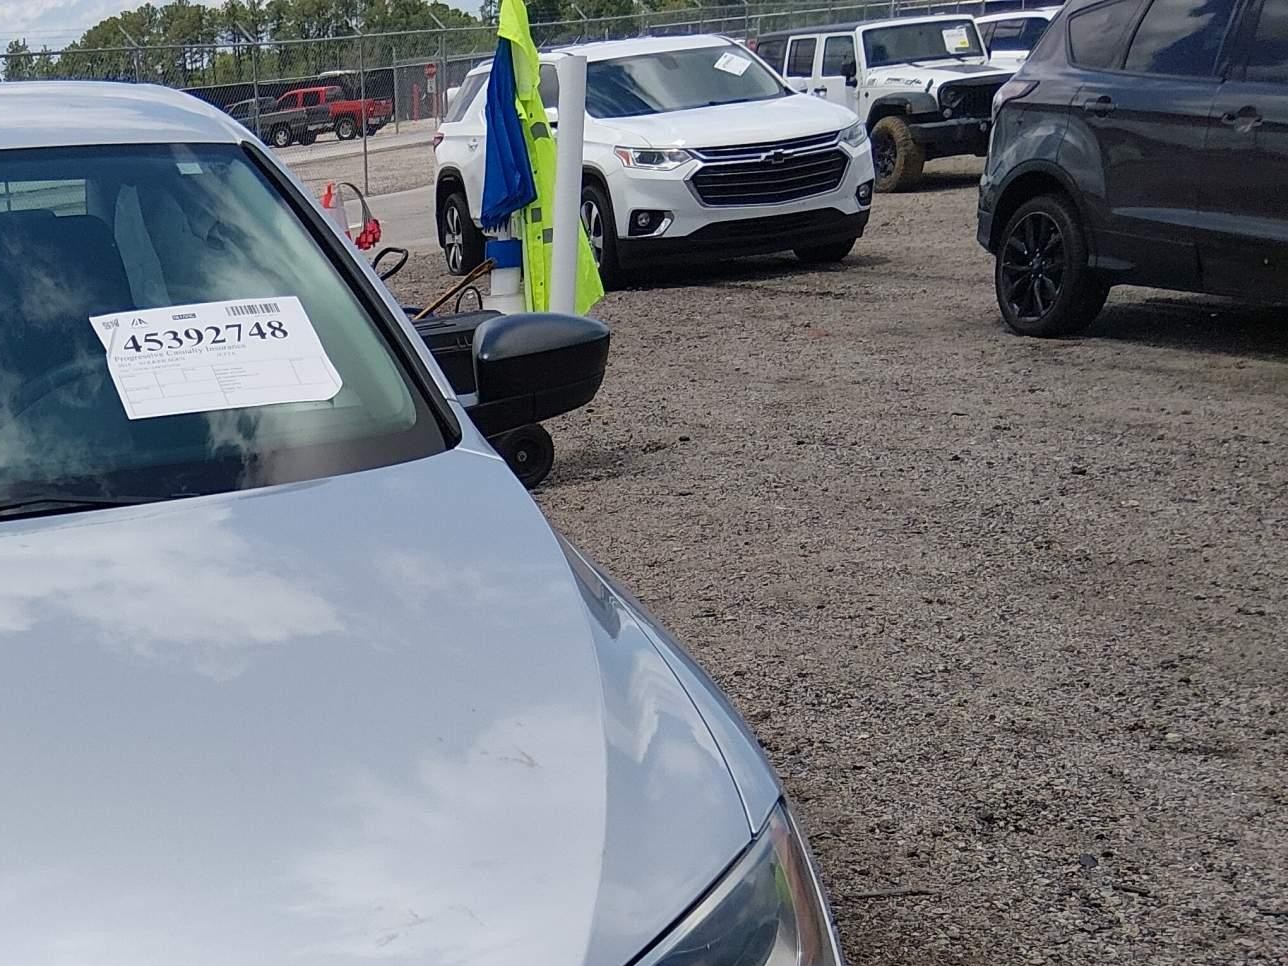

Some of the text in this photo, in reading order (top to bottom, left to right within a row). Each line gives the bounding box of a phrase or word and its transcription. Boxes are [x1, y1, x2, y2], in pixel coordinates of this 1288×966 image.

[123, 320, 289, 353] 45392748
[114, 350, 164, 363] Progressive
[166, 346, 203, 357] Casualty
[205, 343, 247, 353] Insurance
